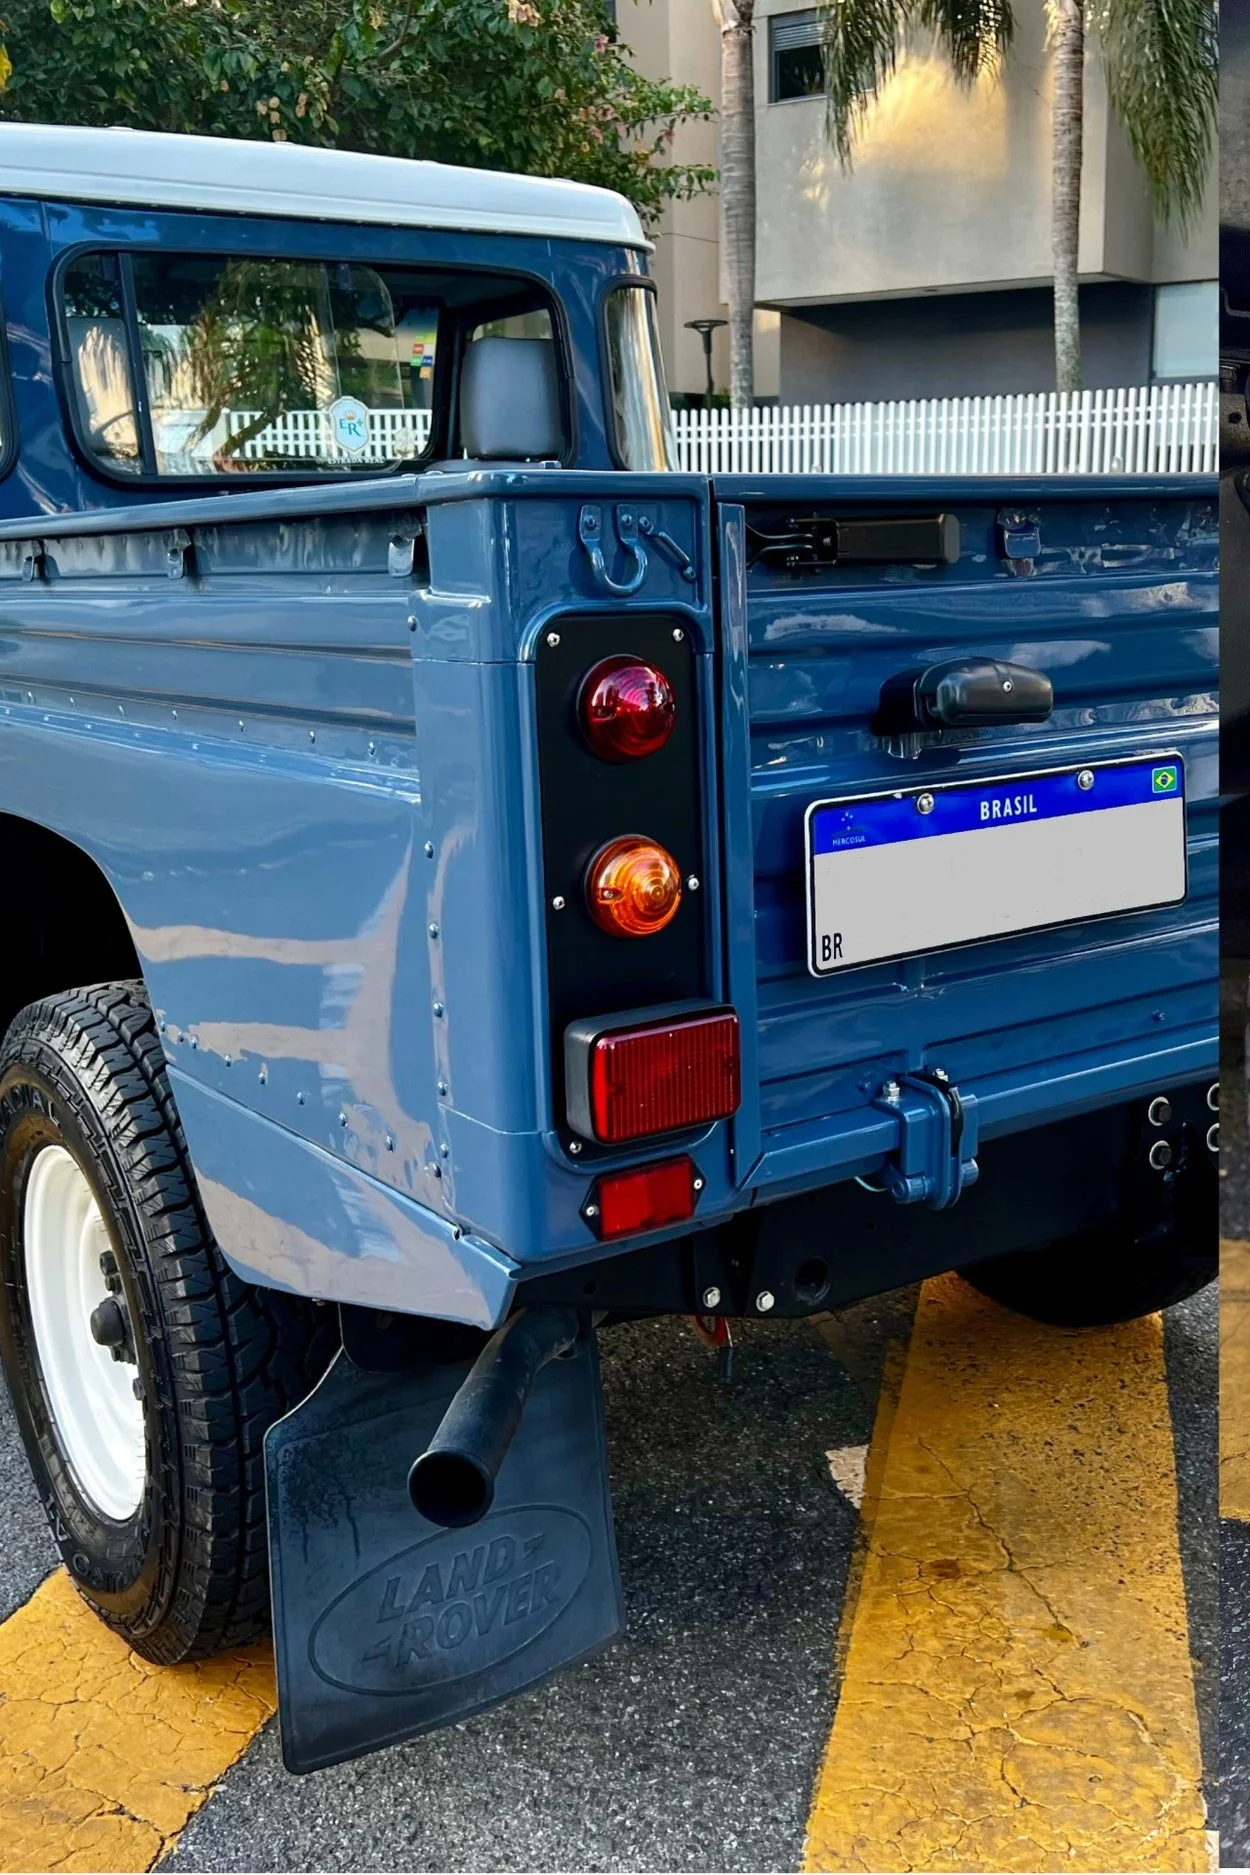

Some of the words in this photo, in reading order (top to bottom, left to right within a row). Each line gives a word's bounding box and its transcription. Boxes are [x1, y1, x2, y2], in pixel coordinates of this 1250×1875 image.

[363, 455, 385, 464] REAL
[980, 794, 1038, 821] BRASIL
[832, 835, 866, 847] MERCOSUL
[821, 932, 844, 962] BR
[377, 1535, 516, 1624] LAND
[395, 1560, 562, 1667] ROVER
